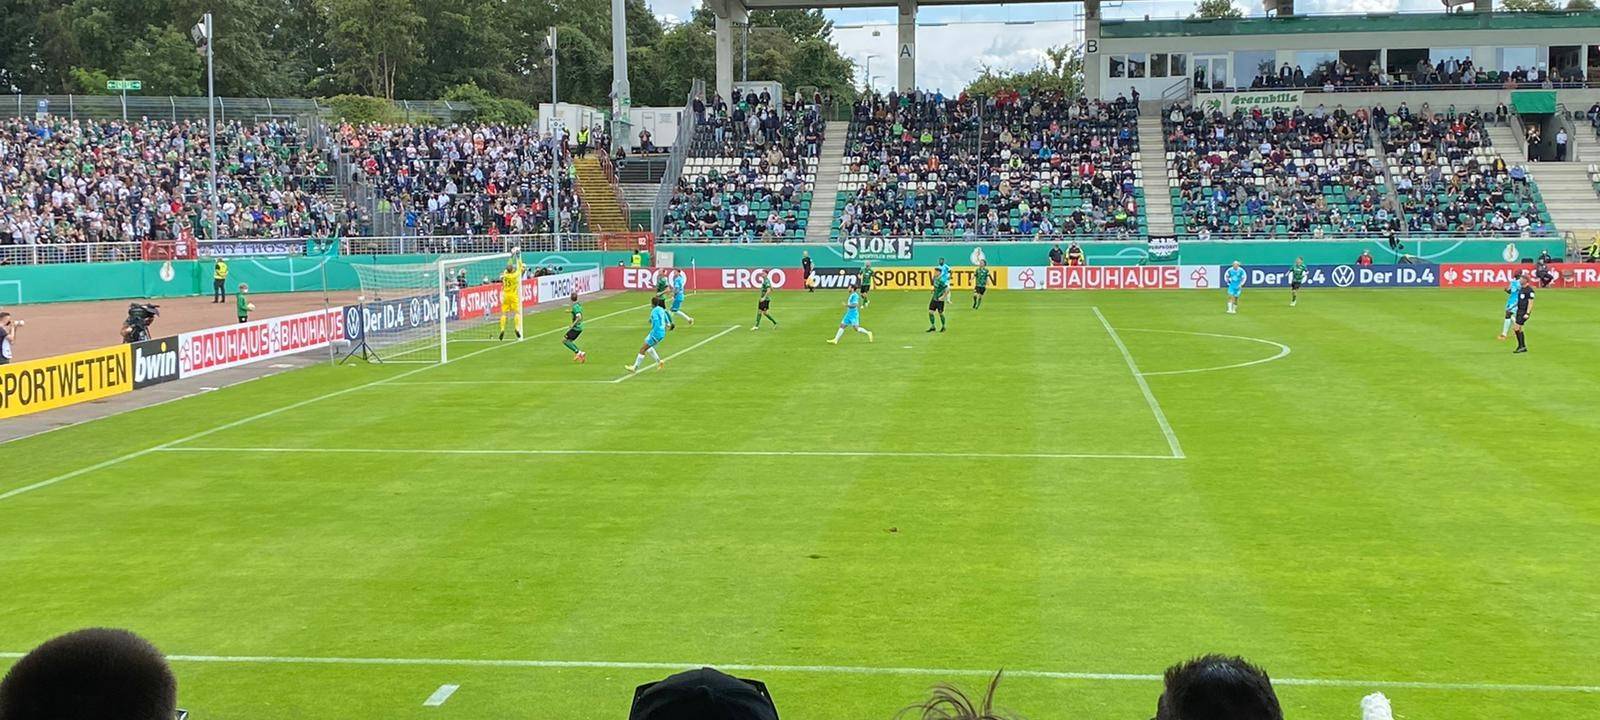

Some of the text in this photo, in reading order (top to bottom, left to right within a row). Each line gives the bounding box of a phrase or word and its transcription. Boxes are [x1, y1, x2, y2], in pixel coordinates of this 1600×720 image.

[900, 44, 911, 57] A
[1087, 40, 1097, 53] B
[213, 241, 287, 254] MYTHOS
[843, 237, 912, 259] SLOKE
[722, 268, 786, 288] ERGO
[809, 269, 857, 288] bwin
[874, 270, 997, 286] SPORTTTN
[1049, 269, 1179, 286] BAUHAUS
[1252, 269, 1282, 284] Der
[1360, 269, 1435, 284] Der ID.4
[443, 295, 458, 318] D.4
[363, 303, 404, 333] Der ID.4
[280, 315, 342, 349] BAUHAUS
[192, 328, 269, 368] BAUHAUS
[134, 341, 177, 383] bwin
[0, 352, 127, 409] PORTWETTEN
